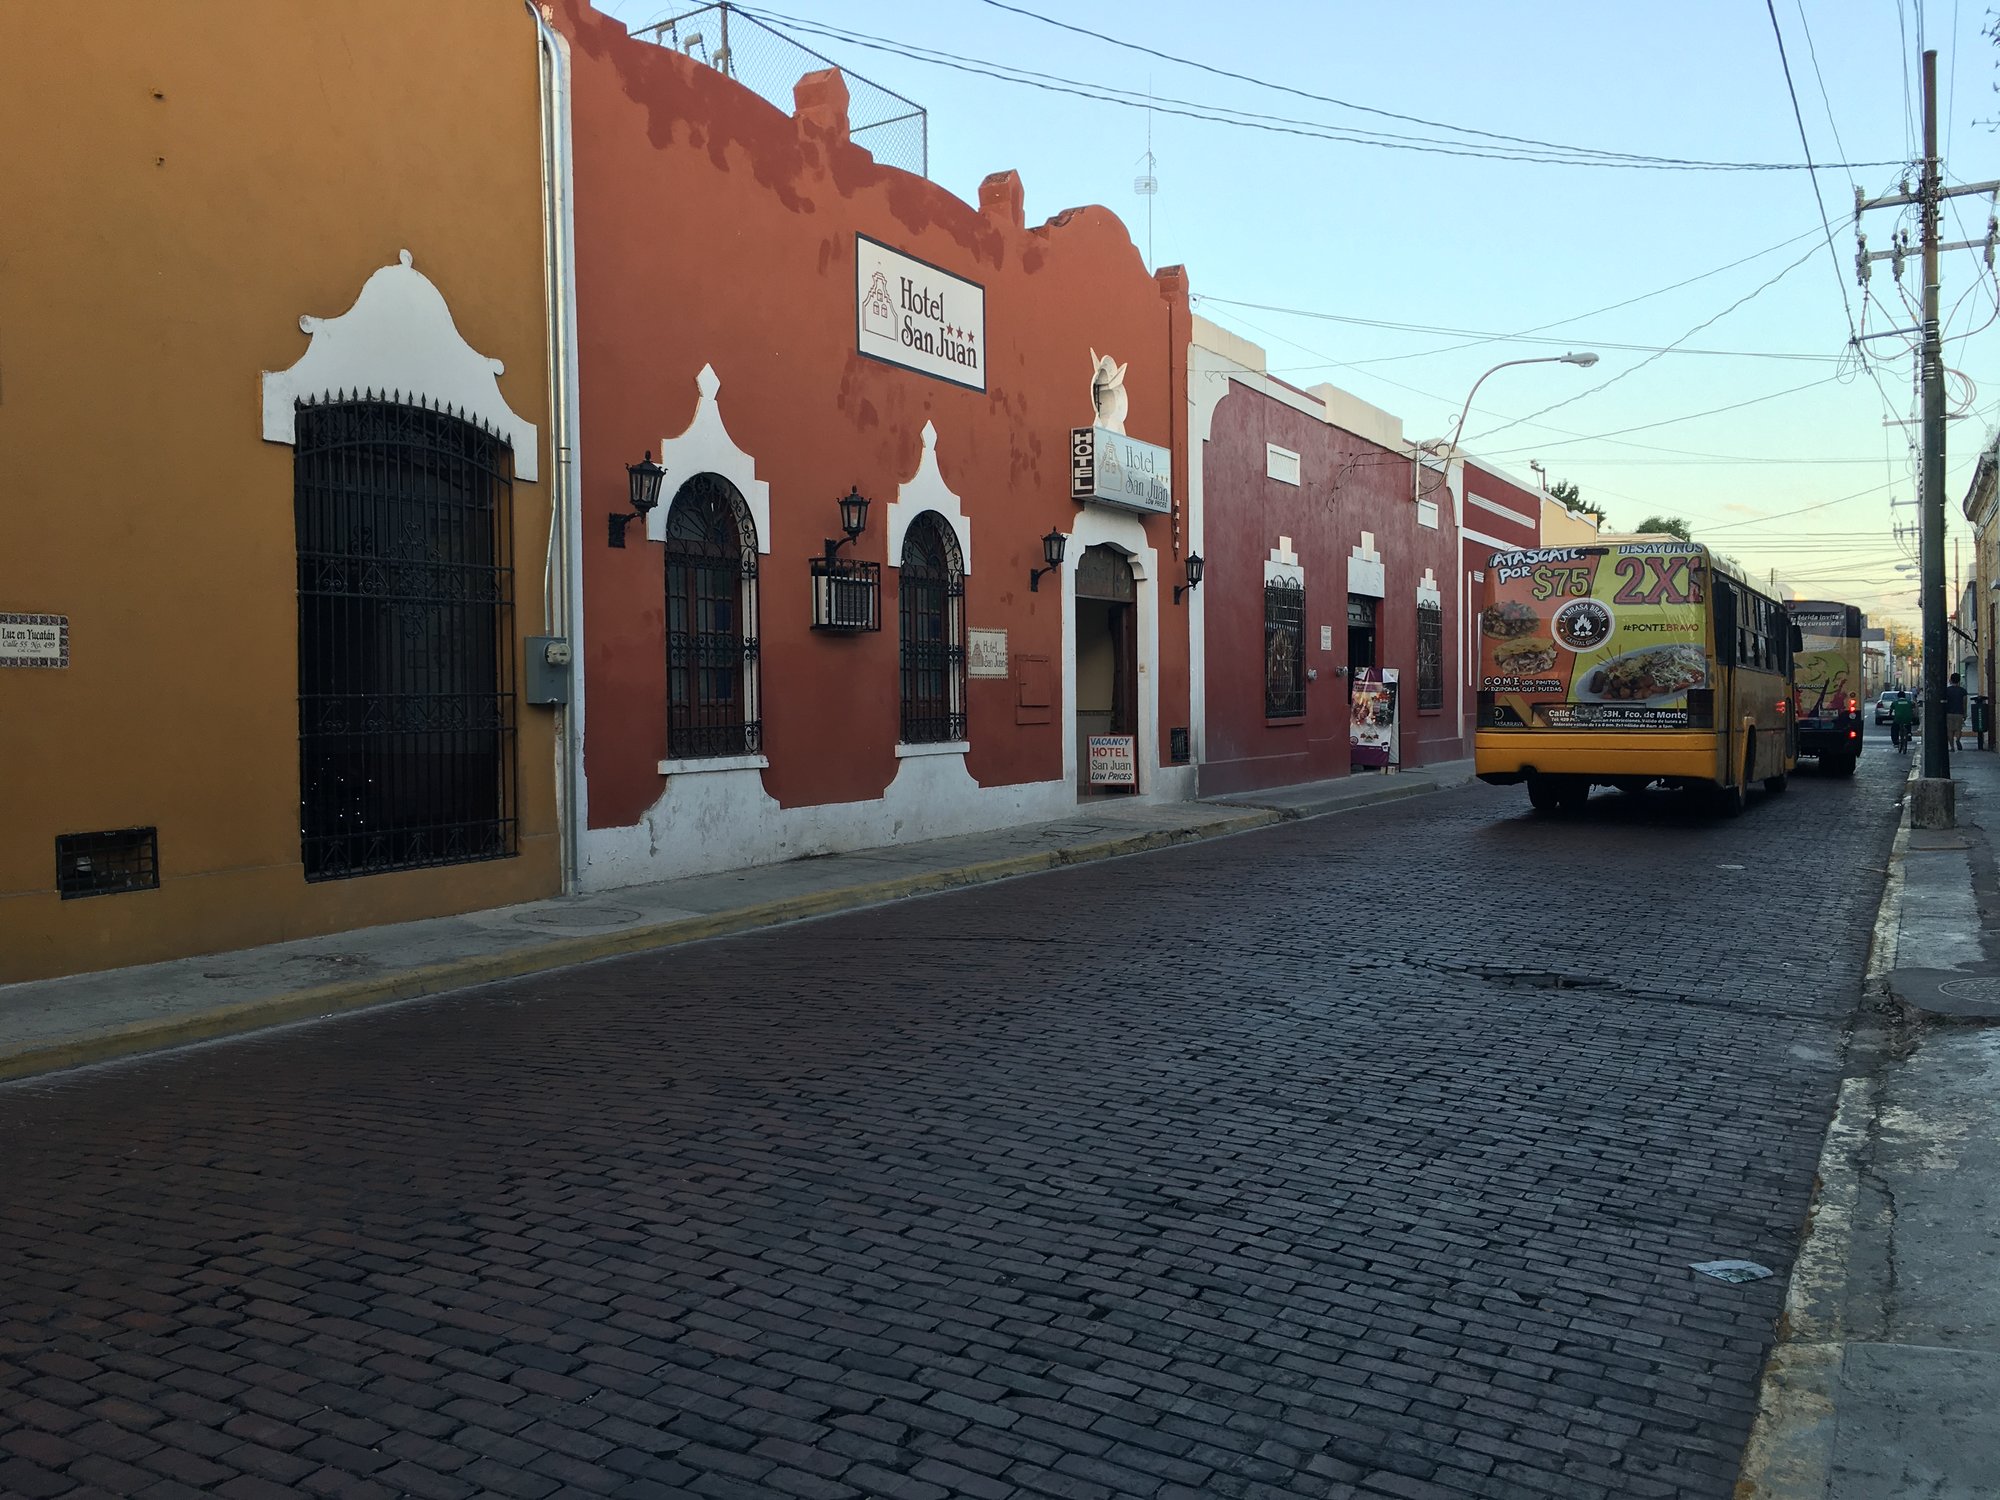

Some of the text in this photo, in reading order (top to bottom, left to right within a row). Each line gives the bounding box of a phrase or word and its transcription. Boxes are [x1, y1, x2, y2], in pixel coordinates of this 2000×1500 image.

[900, 276, 945, 323] Hotel
[901, 314, 978, 369] San Juan
[1074, 432, 1093, 490] HOTEL
[1125, 445, 1154, 474] Hotel
[1125, 471, 1168, 502] San Juan
[1618, 543, 1703, 554] DESAYUNOS
[1489, 548, 1585, 567] ¡ATASCAT
[1499, 566, 1588, 600] POR $75
[1560, 603, 1607, 623] LA BRASA BRAVA
[1623, 623, 1699, 632] #PONTEBRAVO
[2, 628, 56, 641] Luz en Yucatán
[1565, 636, 1600, 646] CAPITAL GRILL
[3, 640, 18, 648] Calle
[20, 640, 28, 648] 55
[43, 641, 56, 649] 499
[983, 640, 998, 654] Hotel
[1484, 677, 1520, 686] COME
[1090, 738, 1130, 746] VACANCY
[1092, 747, 1129, 757] HOTEL
[1092, 760, 1131, 770] San Juan
[1092, 771, 1132, 780] LOW PRICES
